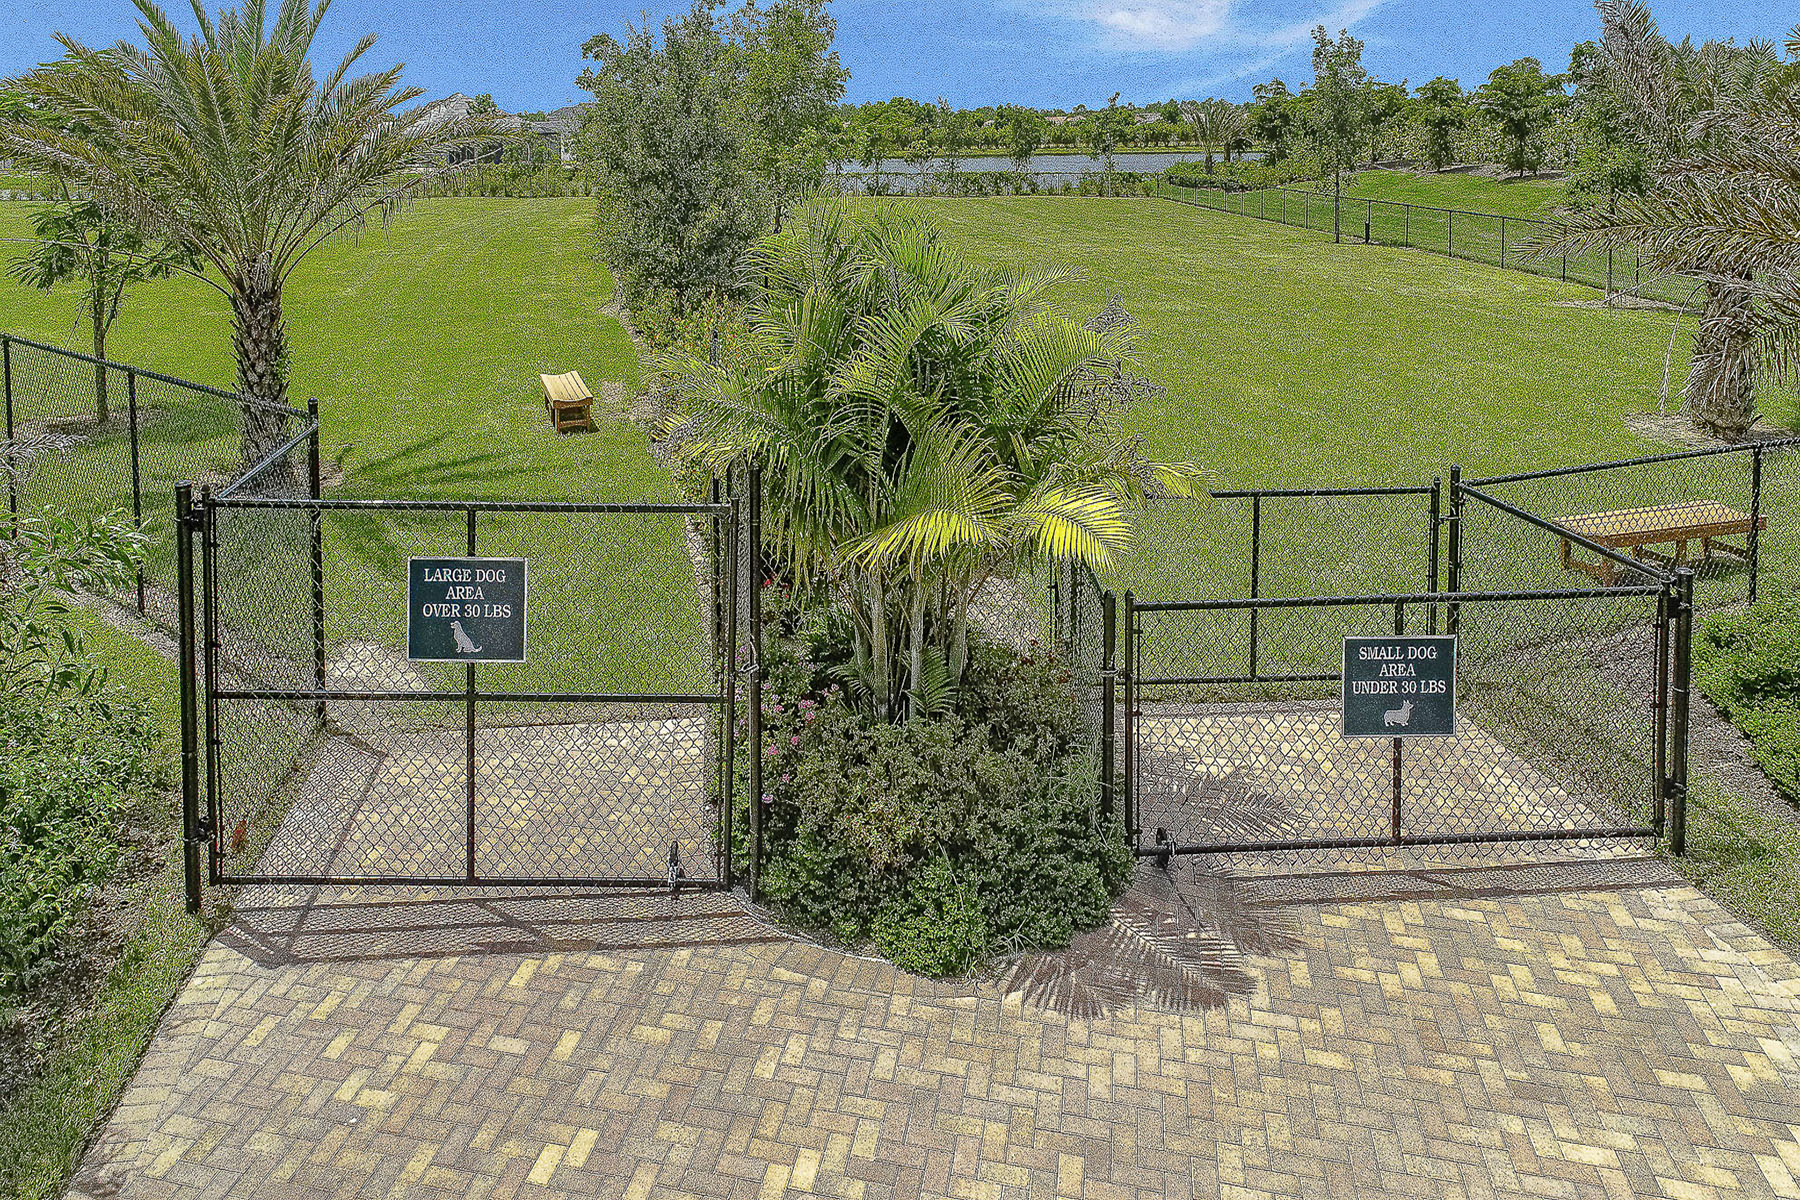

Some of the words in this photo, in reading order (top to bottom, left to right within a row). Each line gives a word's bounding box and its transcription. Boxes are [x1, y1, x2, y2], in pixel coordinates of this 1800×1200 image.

[424, 568, 472, 582] LARGE
[475, 569, 507, 583] DOG
[445, 586, 485, 600] AREA
[423, 603, 461, 618] OVER
[464, 604, 480, 618] 30
[484, 604, 512, 618] LBS
[1358, 646, 1404, 660] SMALL
[1407, 646, 1438, 660] DOG
[1379, 663, 1416, 677] AREA
[1352, 680, 1398, 694] UNDER
[1401, 680, 1417, 694] 30
[1420, 680, 1447, 694] LBS
